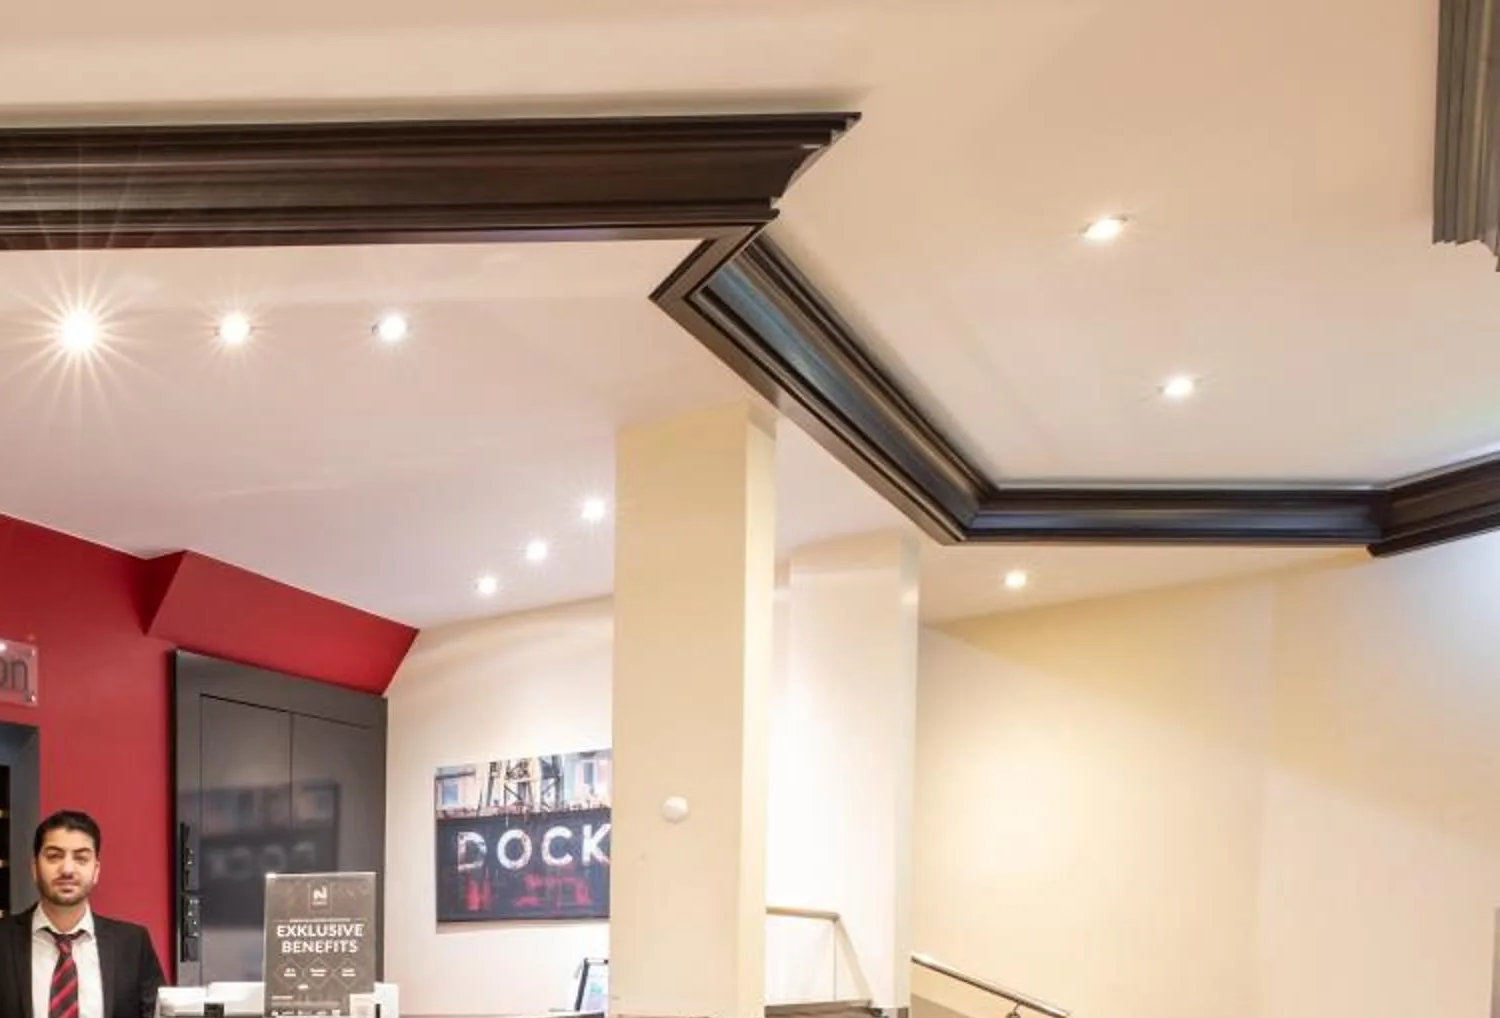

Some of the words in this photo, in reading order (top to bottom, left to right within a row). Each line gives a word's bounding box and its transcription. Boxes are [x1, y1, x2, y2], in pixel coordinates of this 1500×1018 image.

[456, 823, 612, 872] DOCK
[276, 923, 365, 938] EXKLUSIVE
[281, 939, 359, 954] BENEFITS
